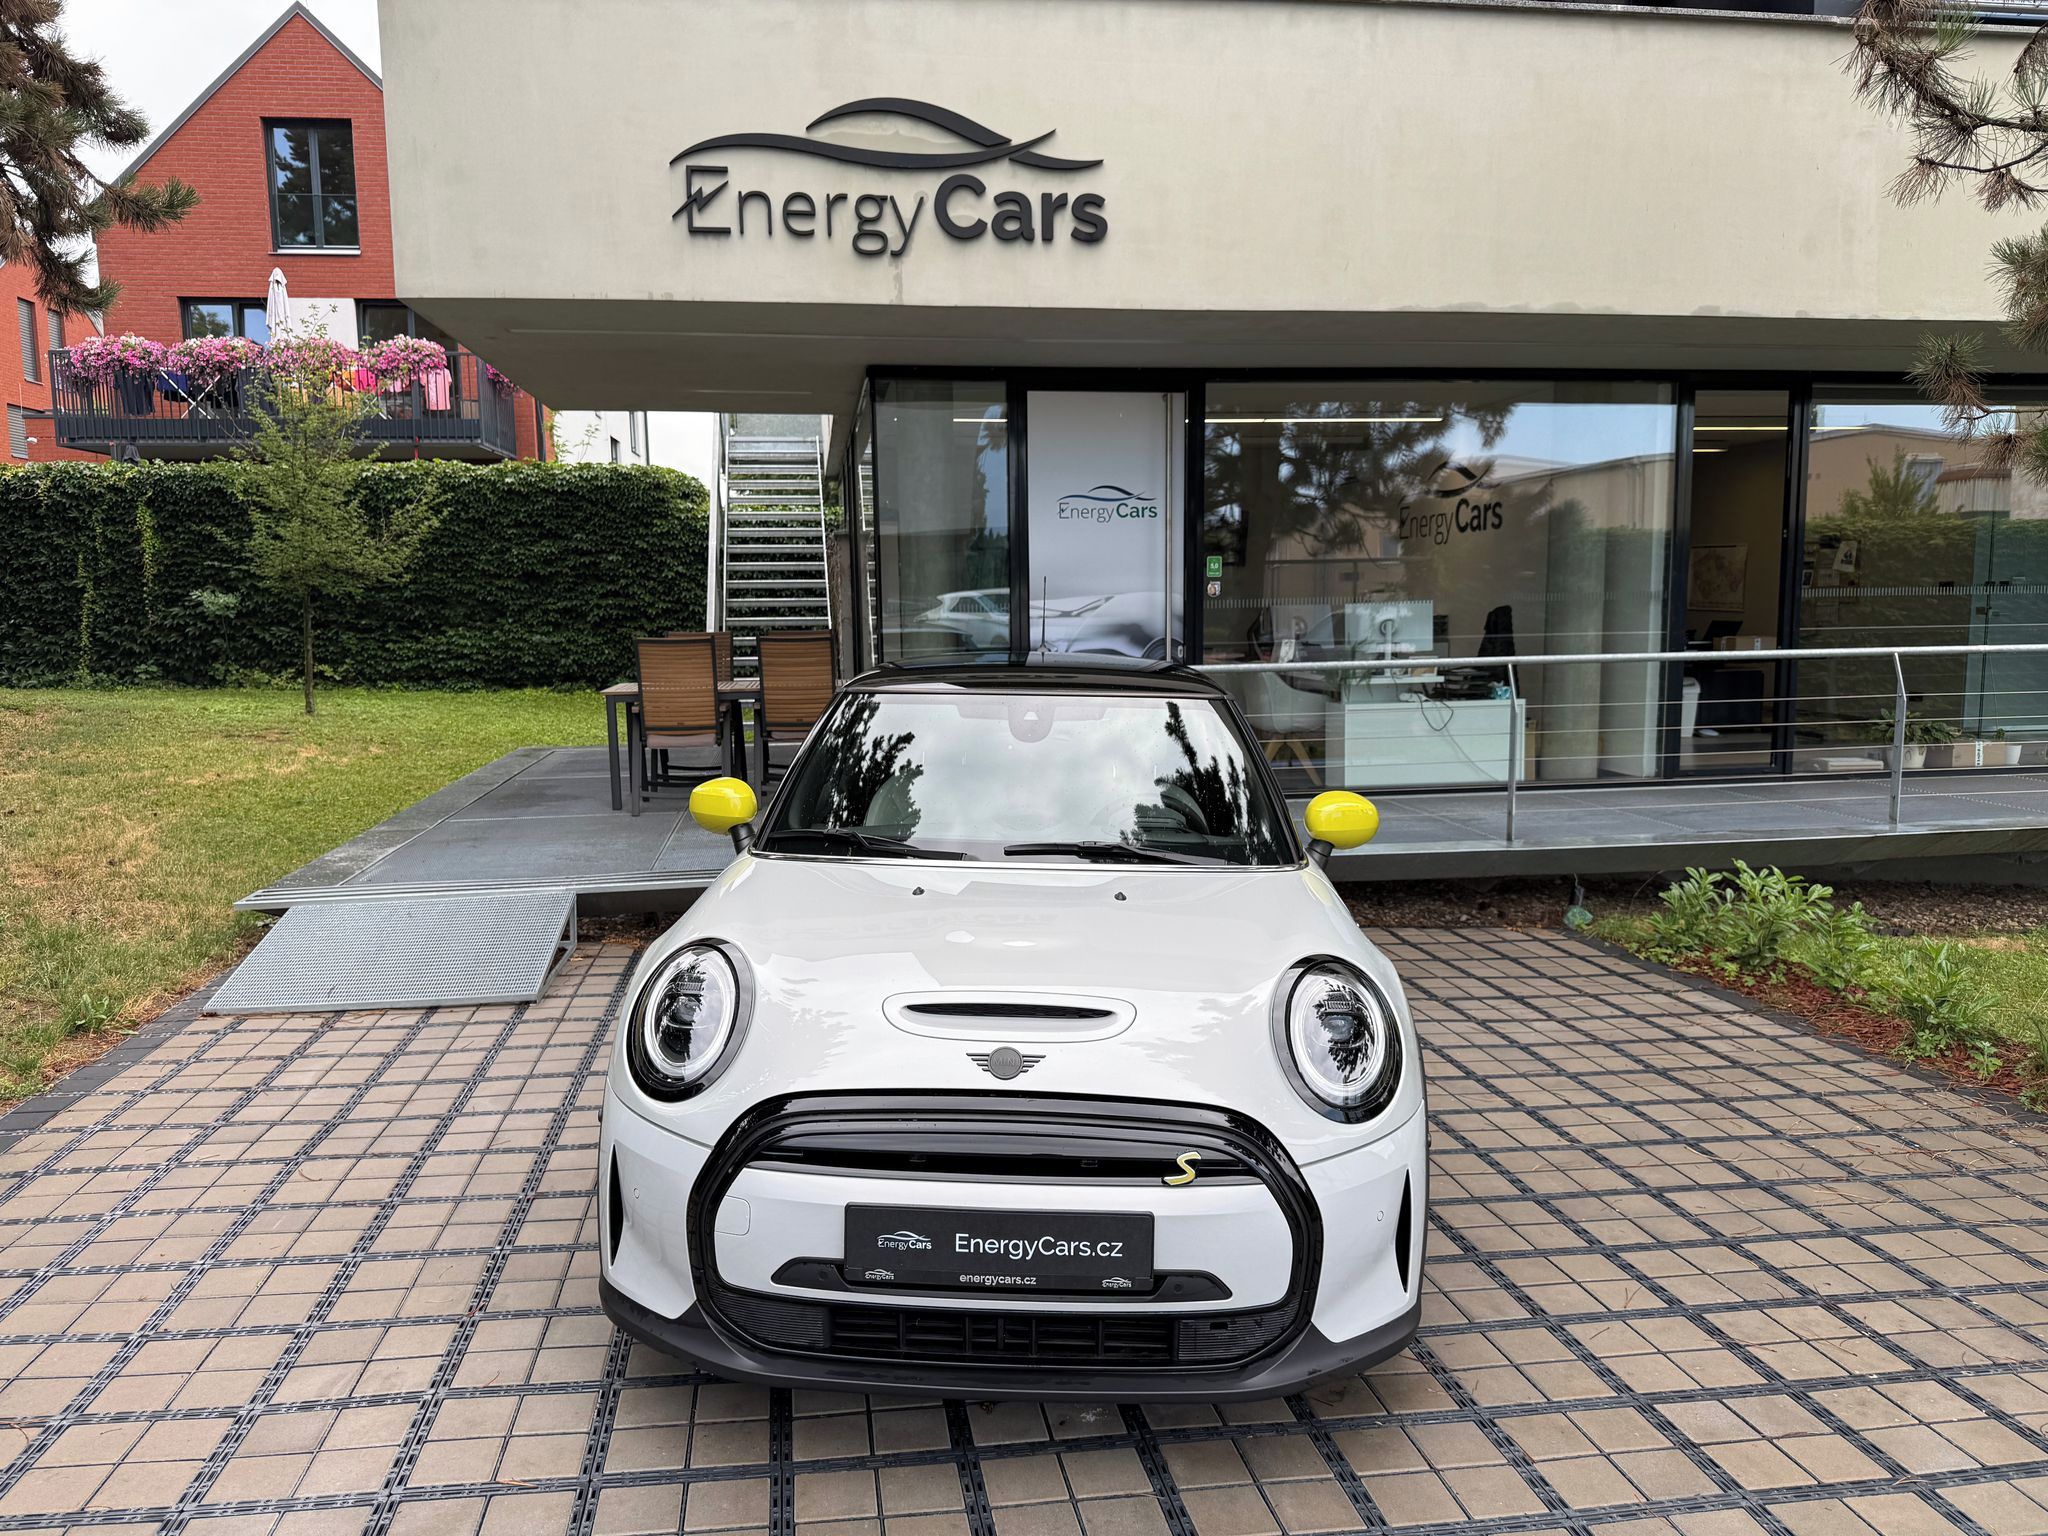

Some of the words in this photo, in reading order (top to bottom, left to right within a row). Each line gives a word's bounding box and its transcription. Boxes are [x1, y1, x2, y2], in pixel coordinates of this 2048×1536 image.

[672, 164, 1108, 256] EnergyCars
[1057, 502, 1158, 523] EnergyCars
[1162, 1151, 1201, 1185] S
[877, 1238, 932, 1250] EnergyCars
[954, 1233, 1123, 1260] EnergyCars.cz
[959, 1274, 1036, 1286] energycars.cz
